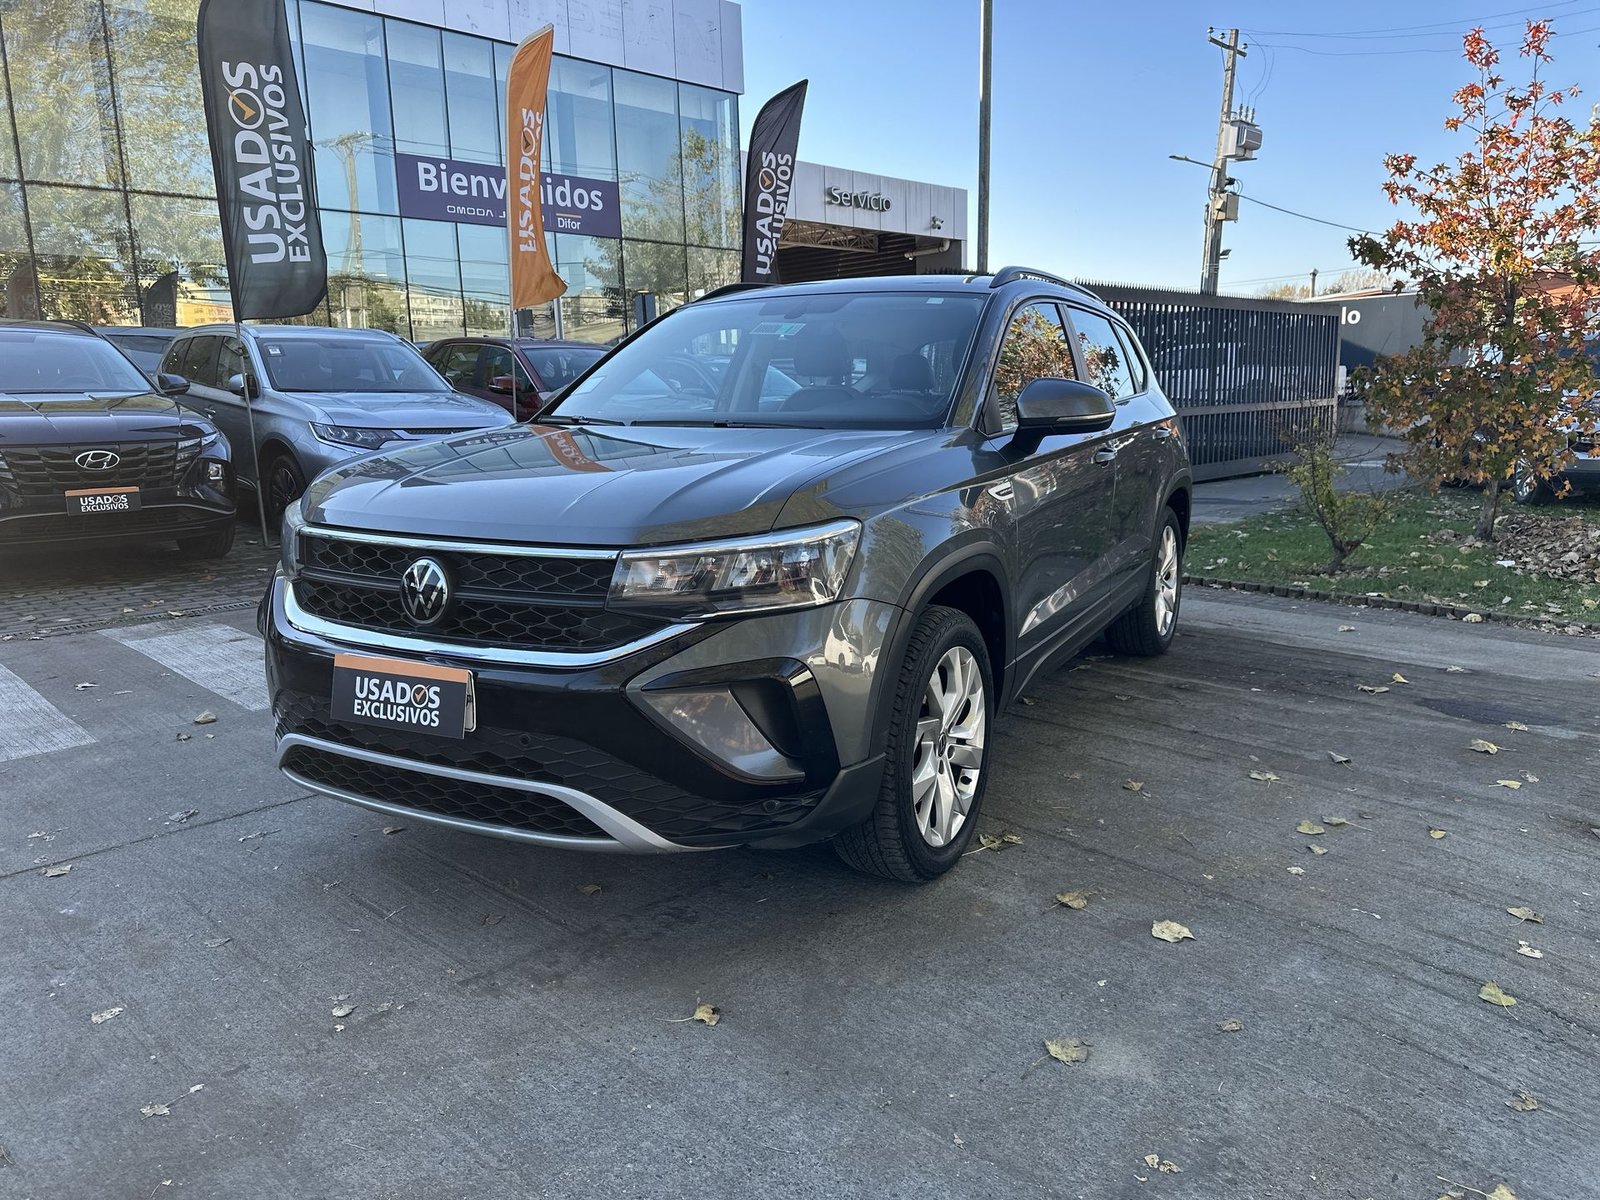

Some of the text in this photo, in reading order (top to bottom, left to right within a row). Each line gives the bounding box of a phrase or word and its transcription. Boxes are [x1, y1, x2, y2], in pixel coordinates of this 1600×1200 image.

[222, 61, 286, 264] USADOS
[259, 64, 311, 263] EXCLUSIVOS
[417, 162, 603, 211] Bienvidos
[829, 186, 892, 212] Servicio
[446, 205, 494, 217] OMODA
[557, 217, 581, 230] Difor
[756, 151, 776, 275] USADOS
[80, 494, 128, 506] USADOS
[81, 502, 129, 512] EXCLUSIVOS
[355, 676, 441, 709] USADOS
[353, 699, 440, 727] EXCLUSIVOS
